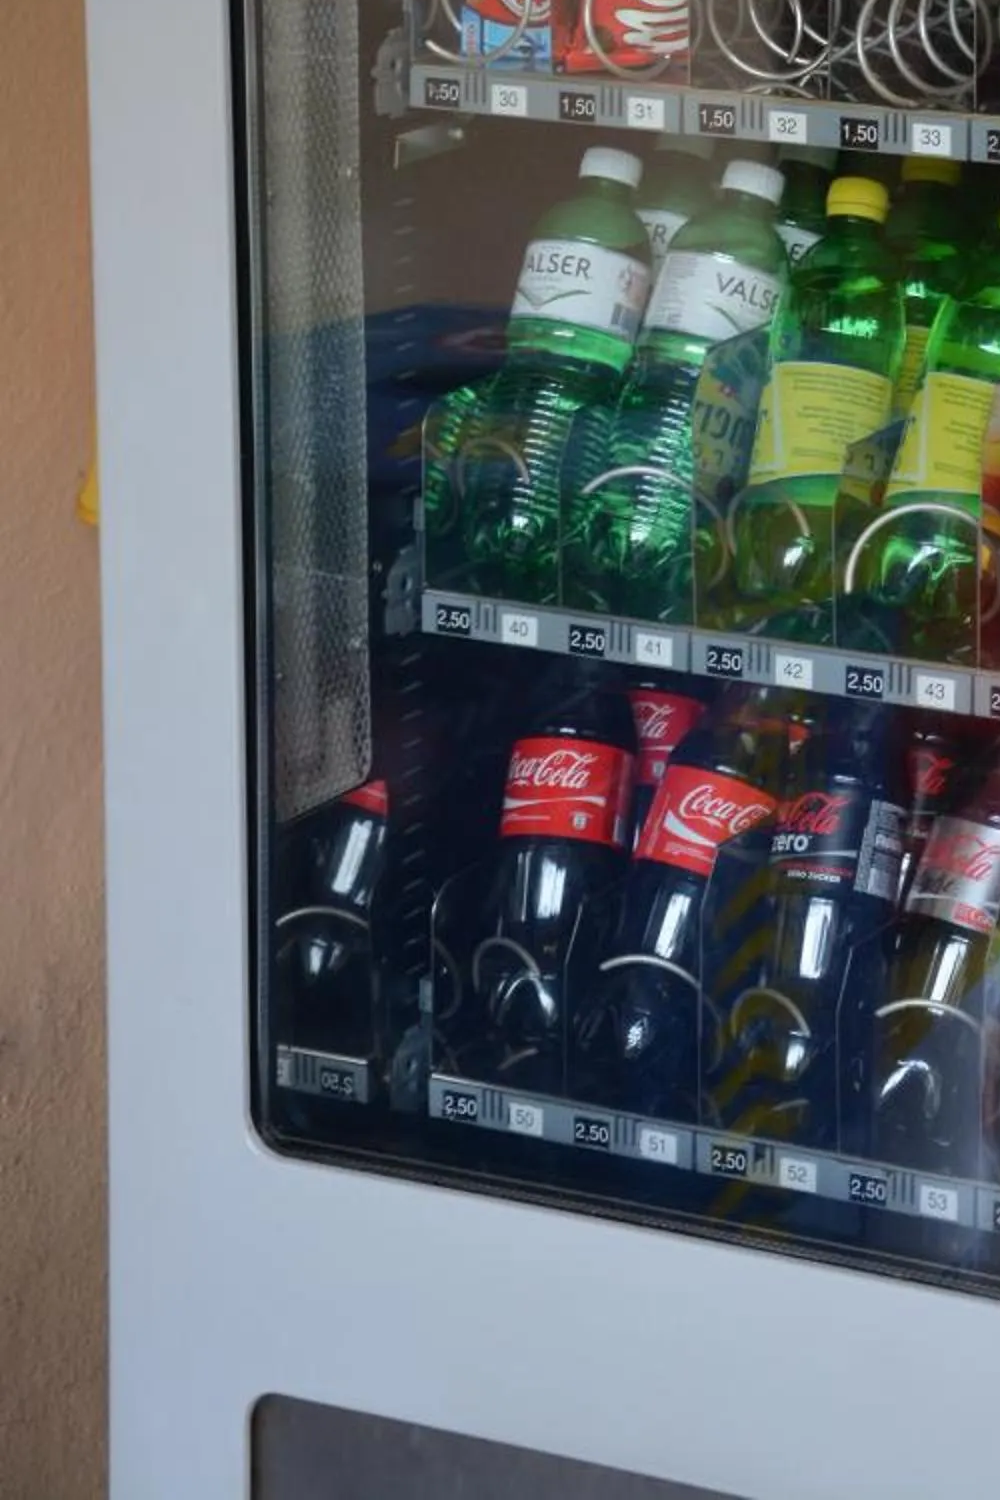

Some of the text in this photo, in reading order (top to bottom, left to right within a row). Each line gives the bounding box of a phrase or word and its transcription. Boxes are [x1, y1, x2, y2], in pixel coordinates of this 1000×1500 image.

[500, 90, 519, 108] 30
[636, 102, 654, 120] 31
[777, 117, 798, 134] 32
[921, 129, 941, 146] 33
[510, 620, 529, 637] 40
[783, 662, 804, 679] 42
[925, 682, 946, 701] 43
[514, 1109, 535, 1128] 50
[649, 1135, 667, 1153] 51
[787, 1165, 807, 1183] 52
[927, 1192, 948, 1212] 53
